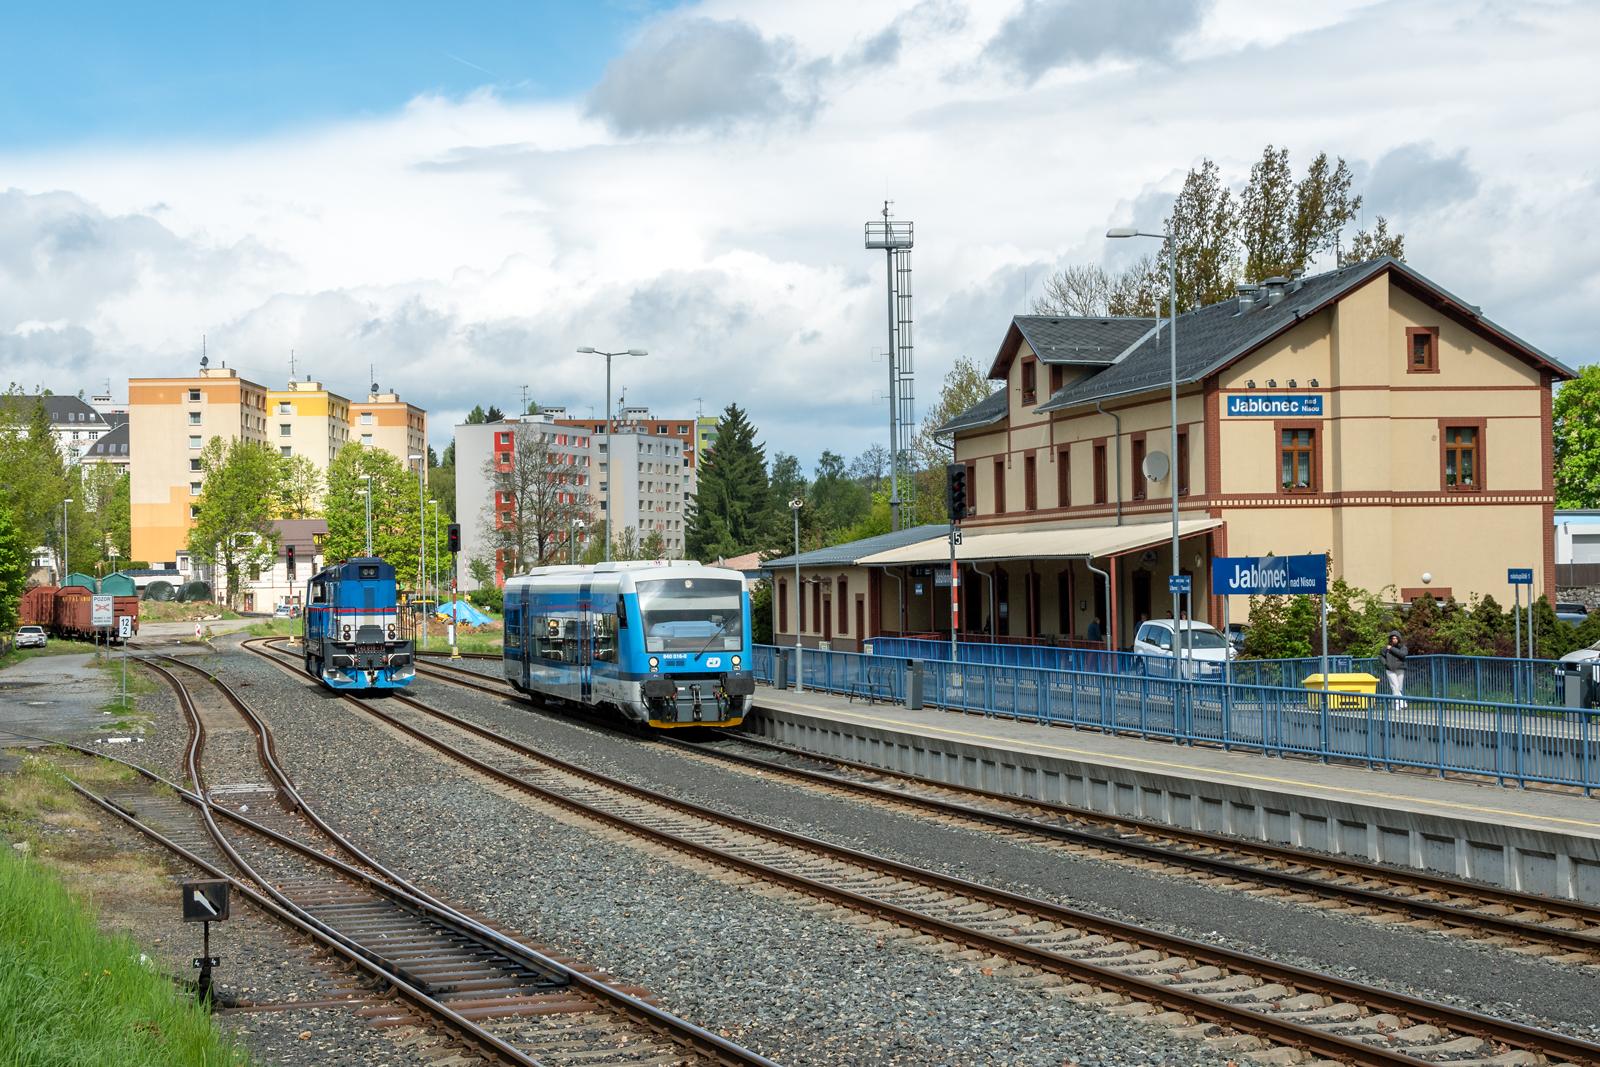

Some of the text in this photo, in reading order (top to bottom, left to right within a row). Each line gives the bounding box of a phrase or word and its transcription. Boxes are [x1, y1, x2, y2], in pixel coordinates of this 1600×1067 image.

[1231, 398, 1299, 412] Jablonec
[955, 532, 961, 545] 5
[1229, 564, 1316, 589] Jablonec nad Nisou
[121, 618, 130, 627] 12
[123, 627, 128, 635] 2
